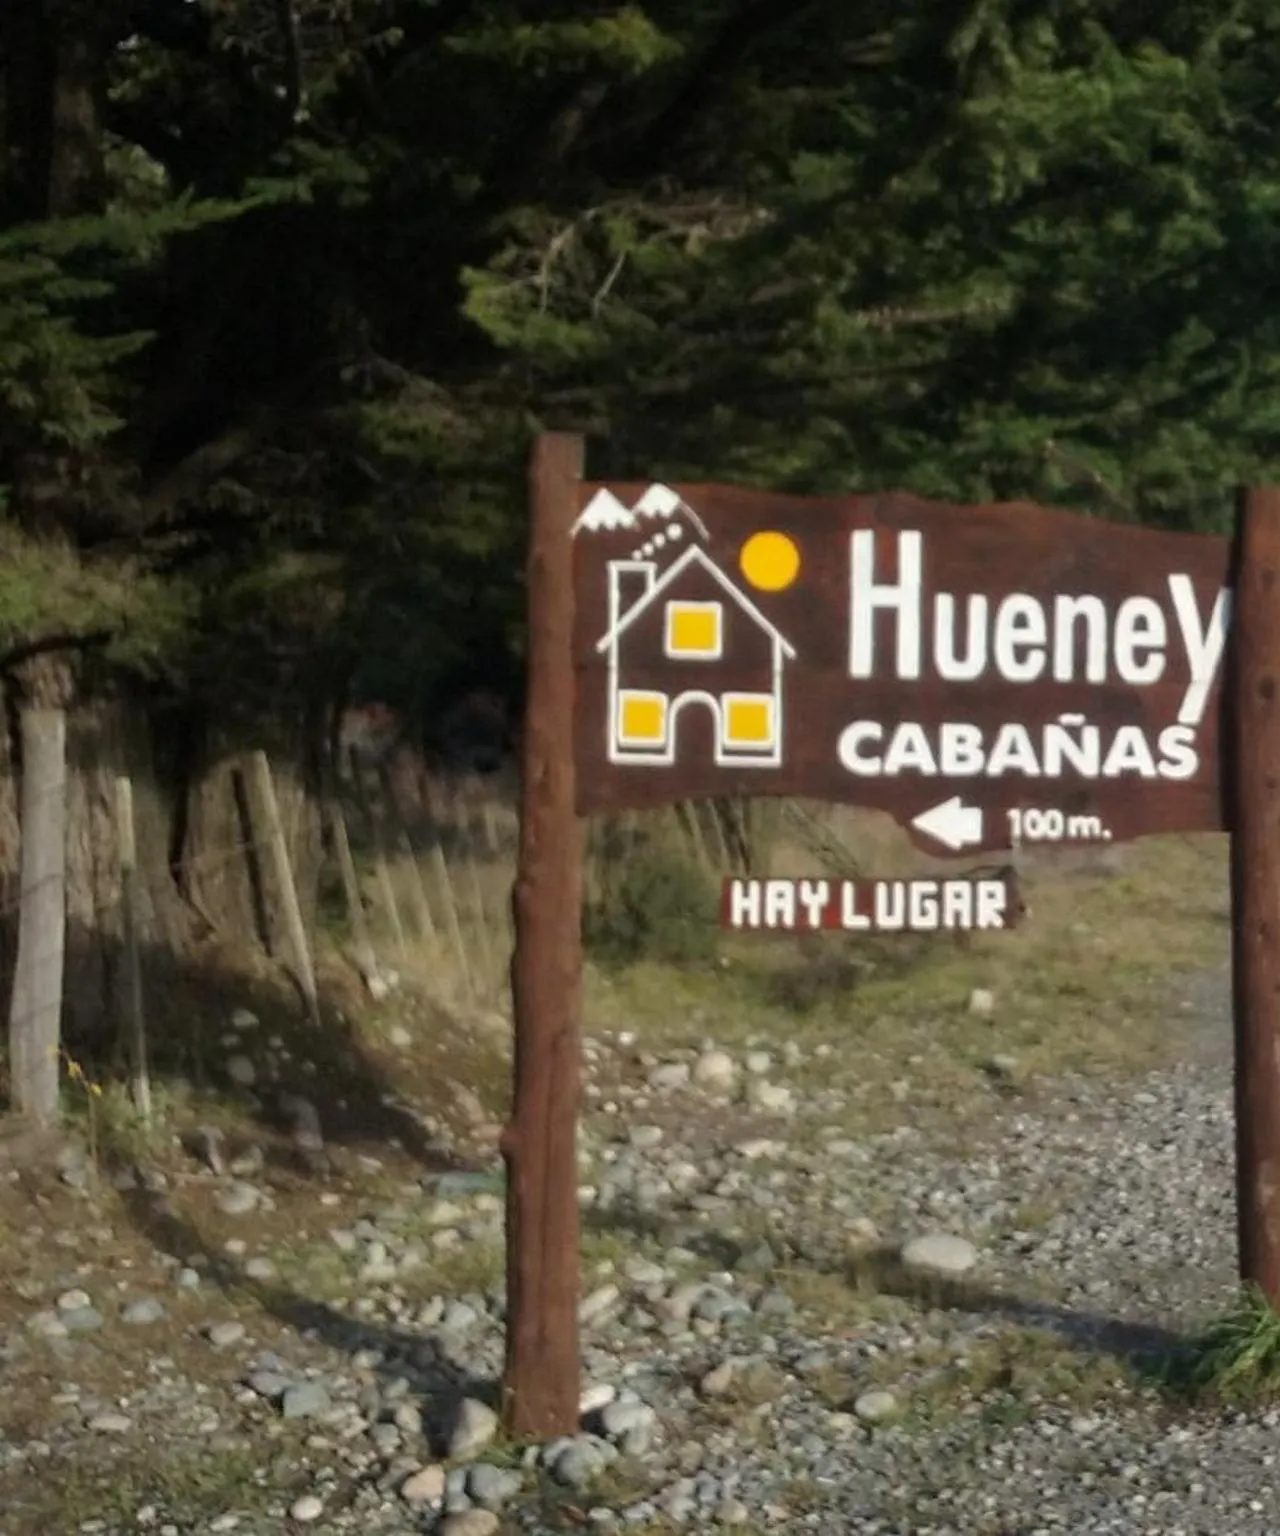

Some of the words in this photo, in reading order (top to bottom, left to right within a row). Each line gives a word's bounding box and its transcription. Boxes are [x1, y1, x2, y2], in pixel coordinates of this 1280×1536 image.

[849, 529, 1229, 724] Hueney
[838, 714, 1198, 778] CABAÑAS
[731, 880, 830, 928] HAY
[841, 881, 1007, 931] LUGAR
